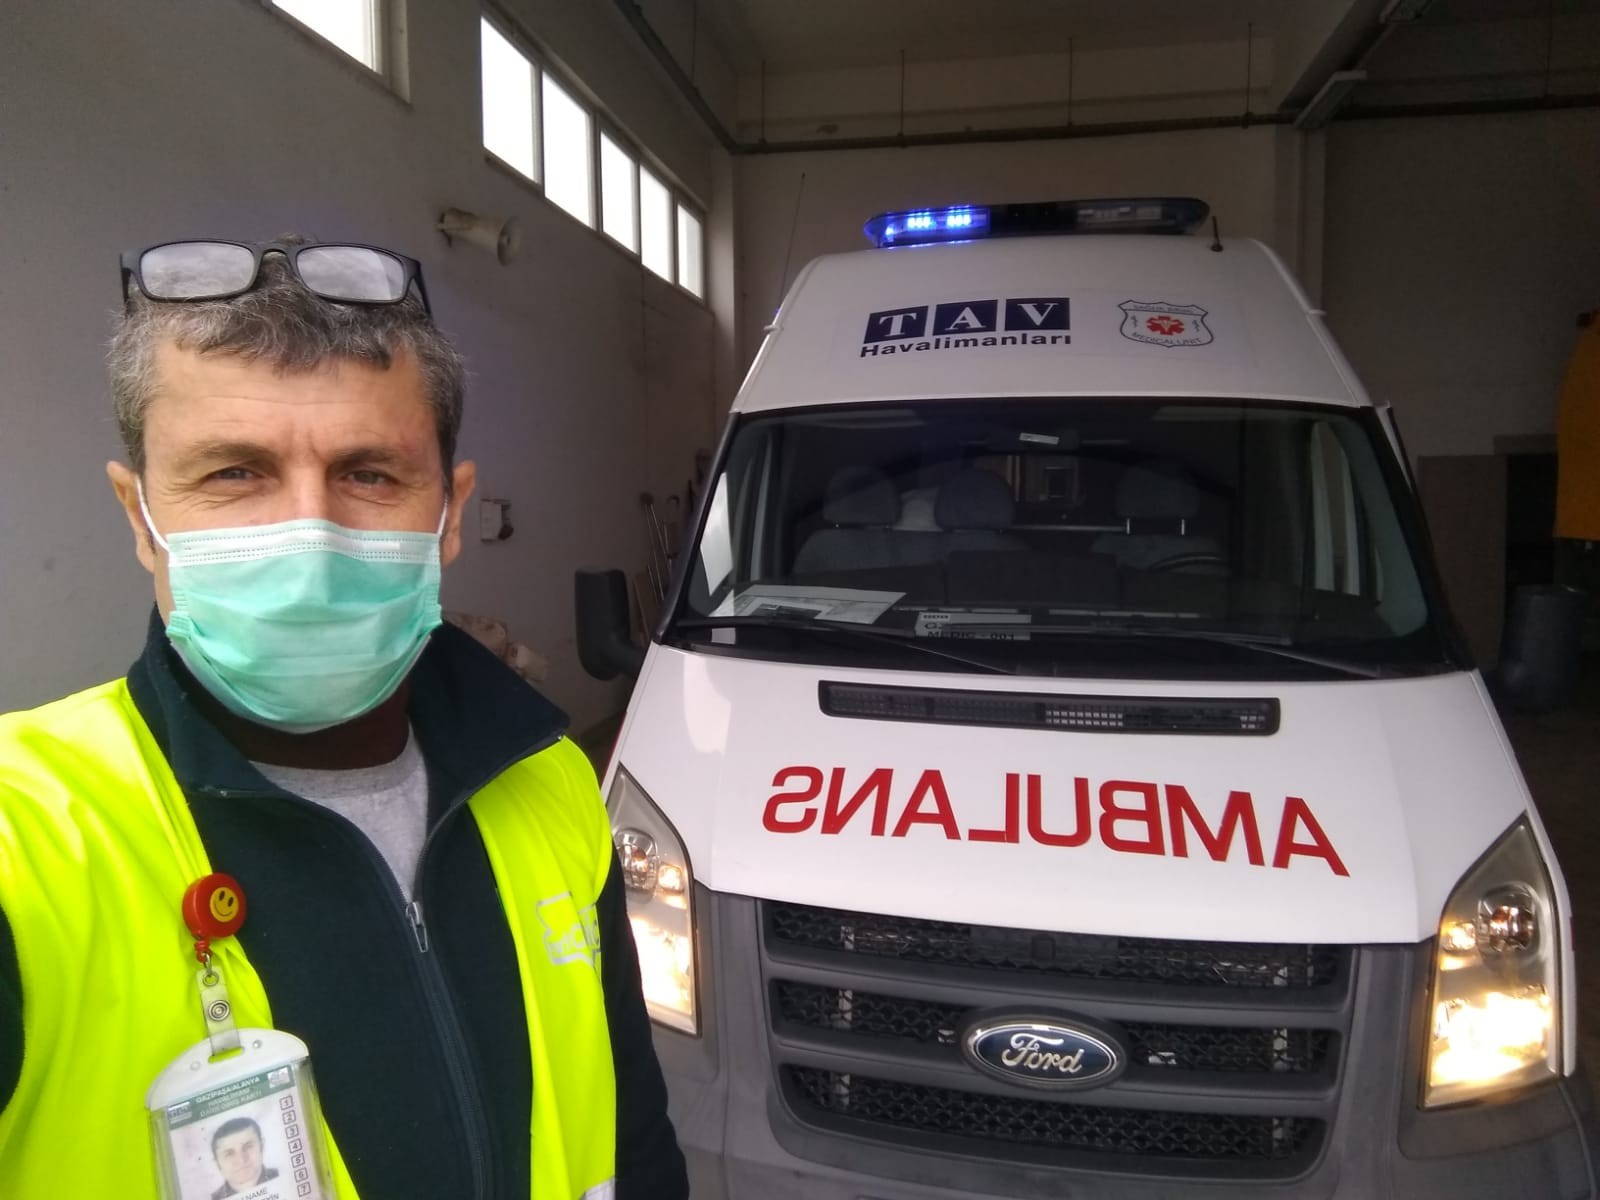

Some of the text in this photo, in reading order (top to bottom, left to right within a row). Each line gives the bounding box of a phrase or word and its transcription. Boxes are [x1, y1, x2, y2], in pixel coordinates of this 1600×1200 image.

[879, 304, 1059, 337] TAV
[861, 333, 1071, 357] Havalimanları
[1002, 1033, 1083, 1073] Ford
